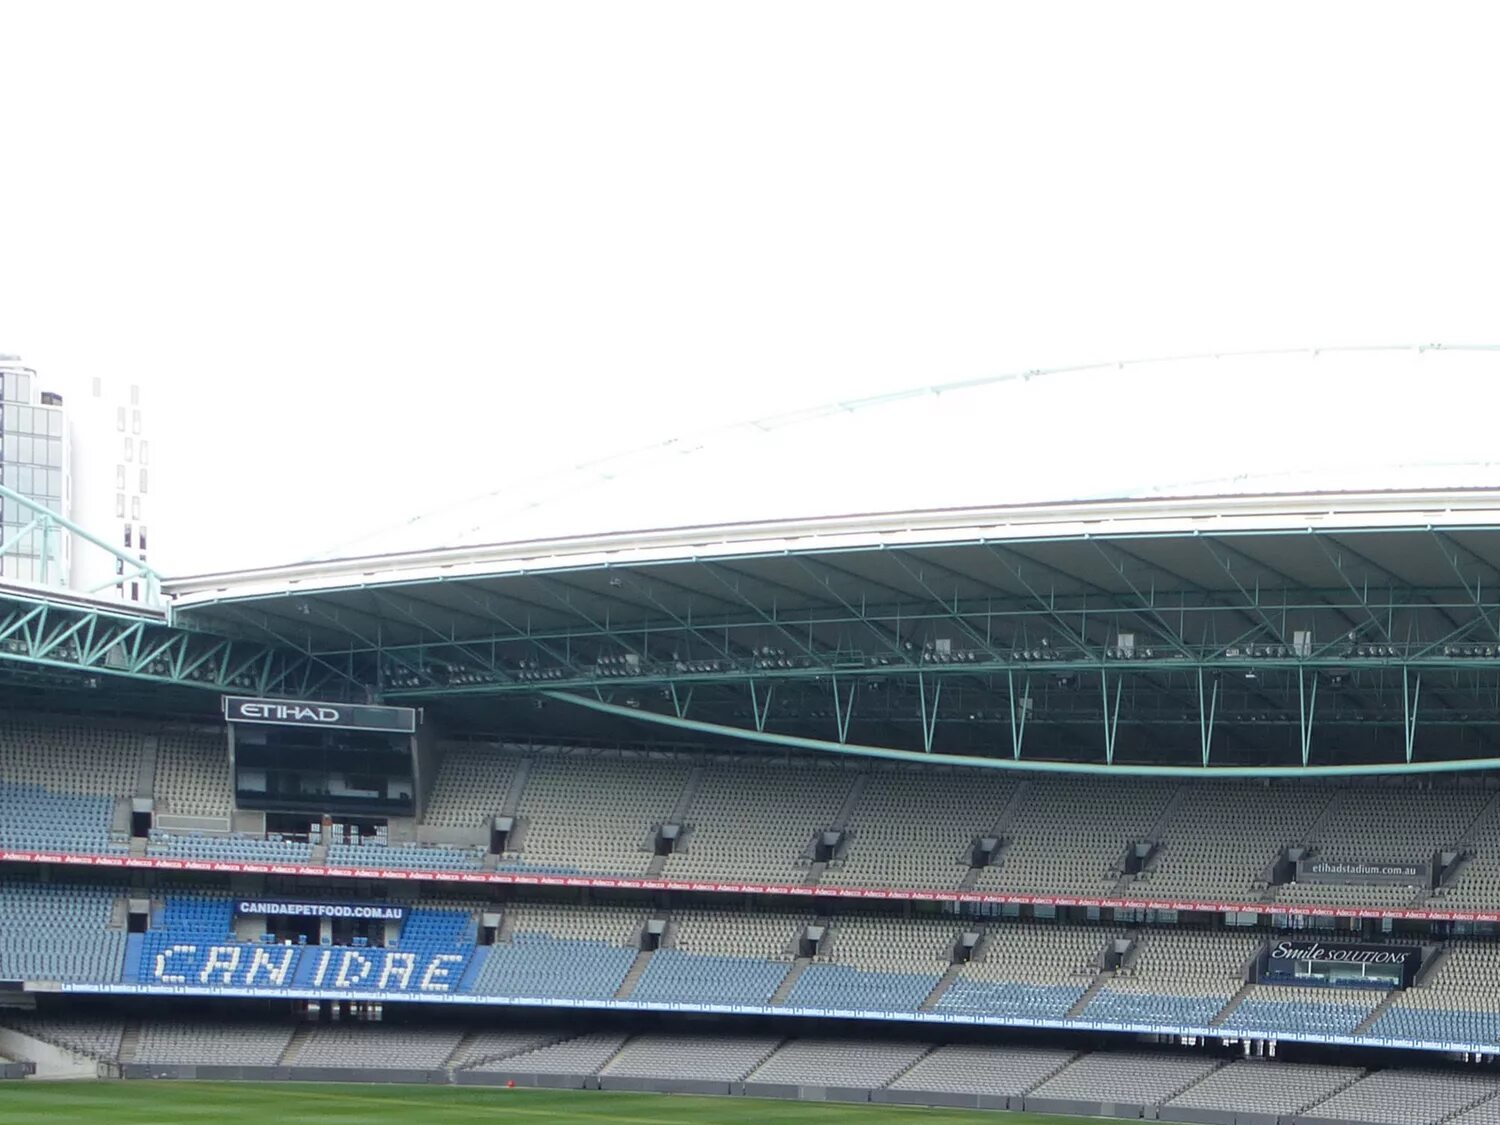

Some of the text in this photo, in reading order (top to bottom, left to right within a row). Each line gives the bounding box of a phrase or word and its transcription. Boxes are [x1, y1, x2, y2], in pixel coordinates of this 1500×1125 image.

[240, 703, 339, 722] ETIHAD
[1312, 863, 1416, 875] etihadstadium.com.au
[240, 902, 402, 919] CANIDAEPETFOOD.COM.AU
[1272, 942, 1407, 964] Smile SOLUTIONS
